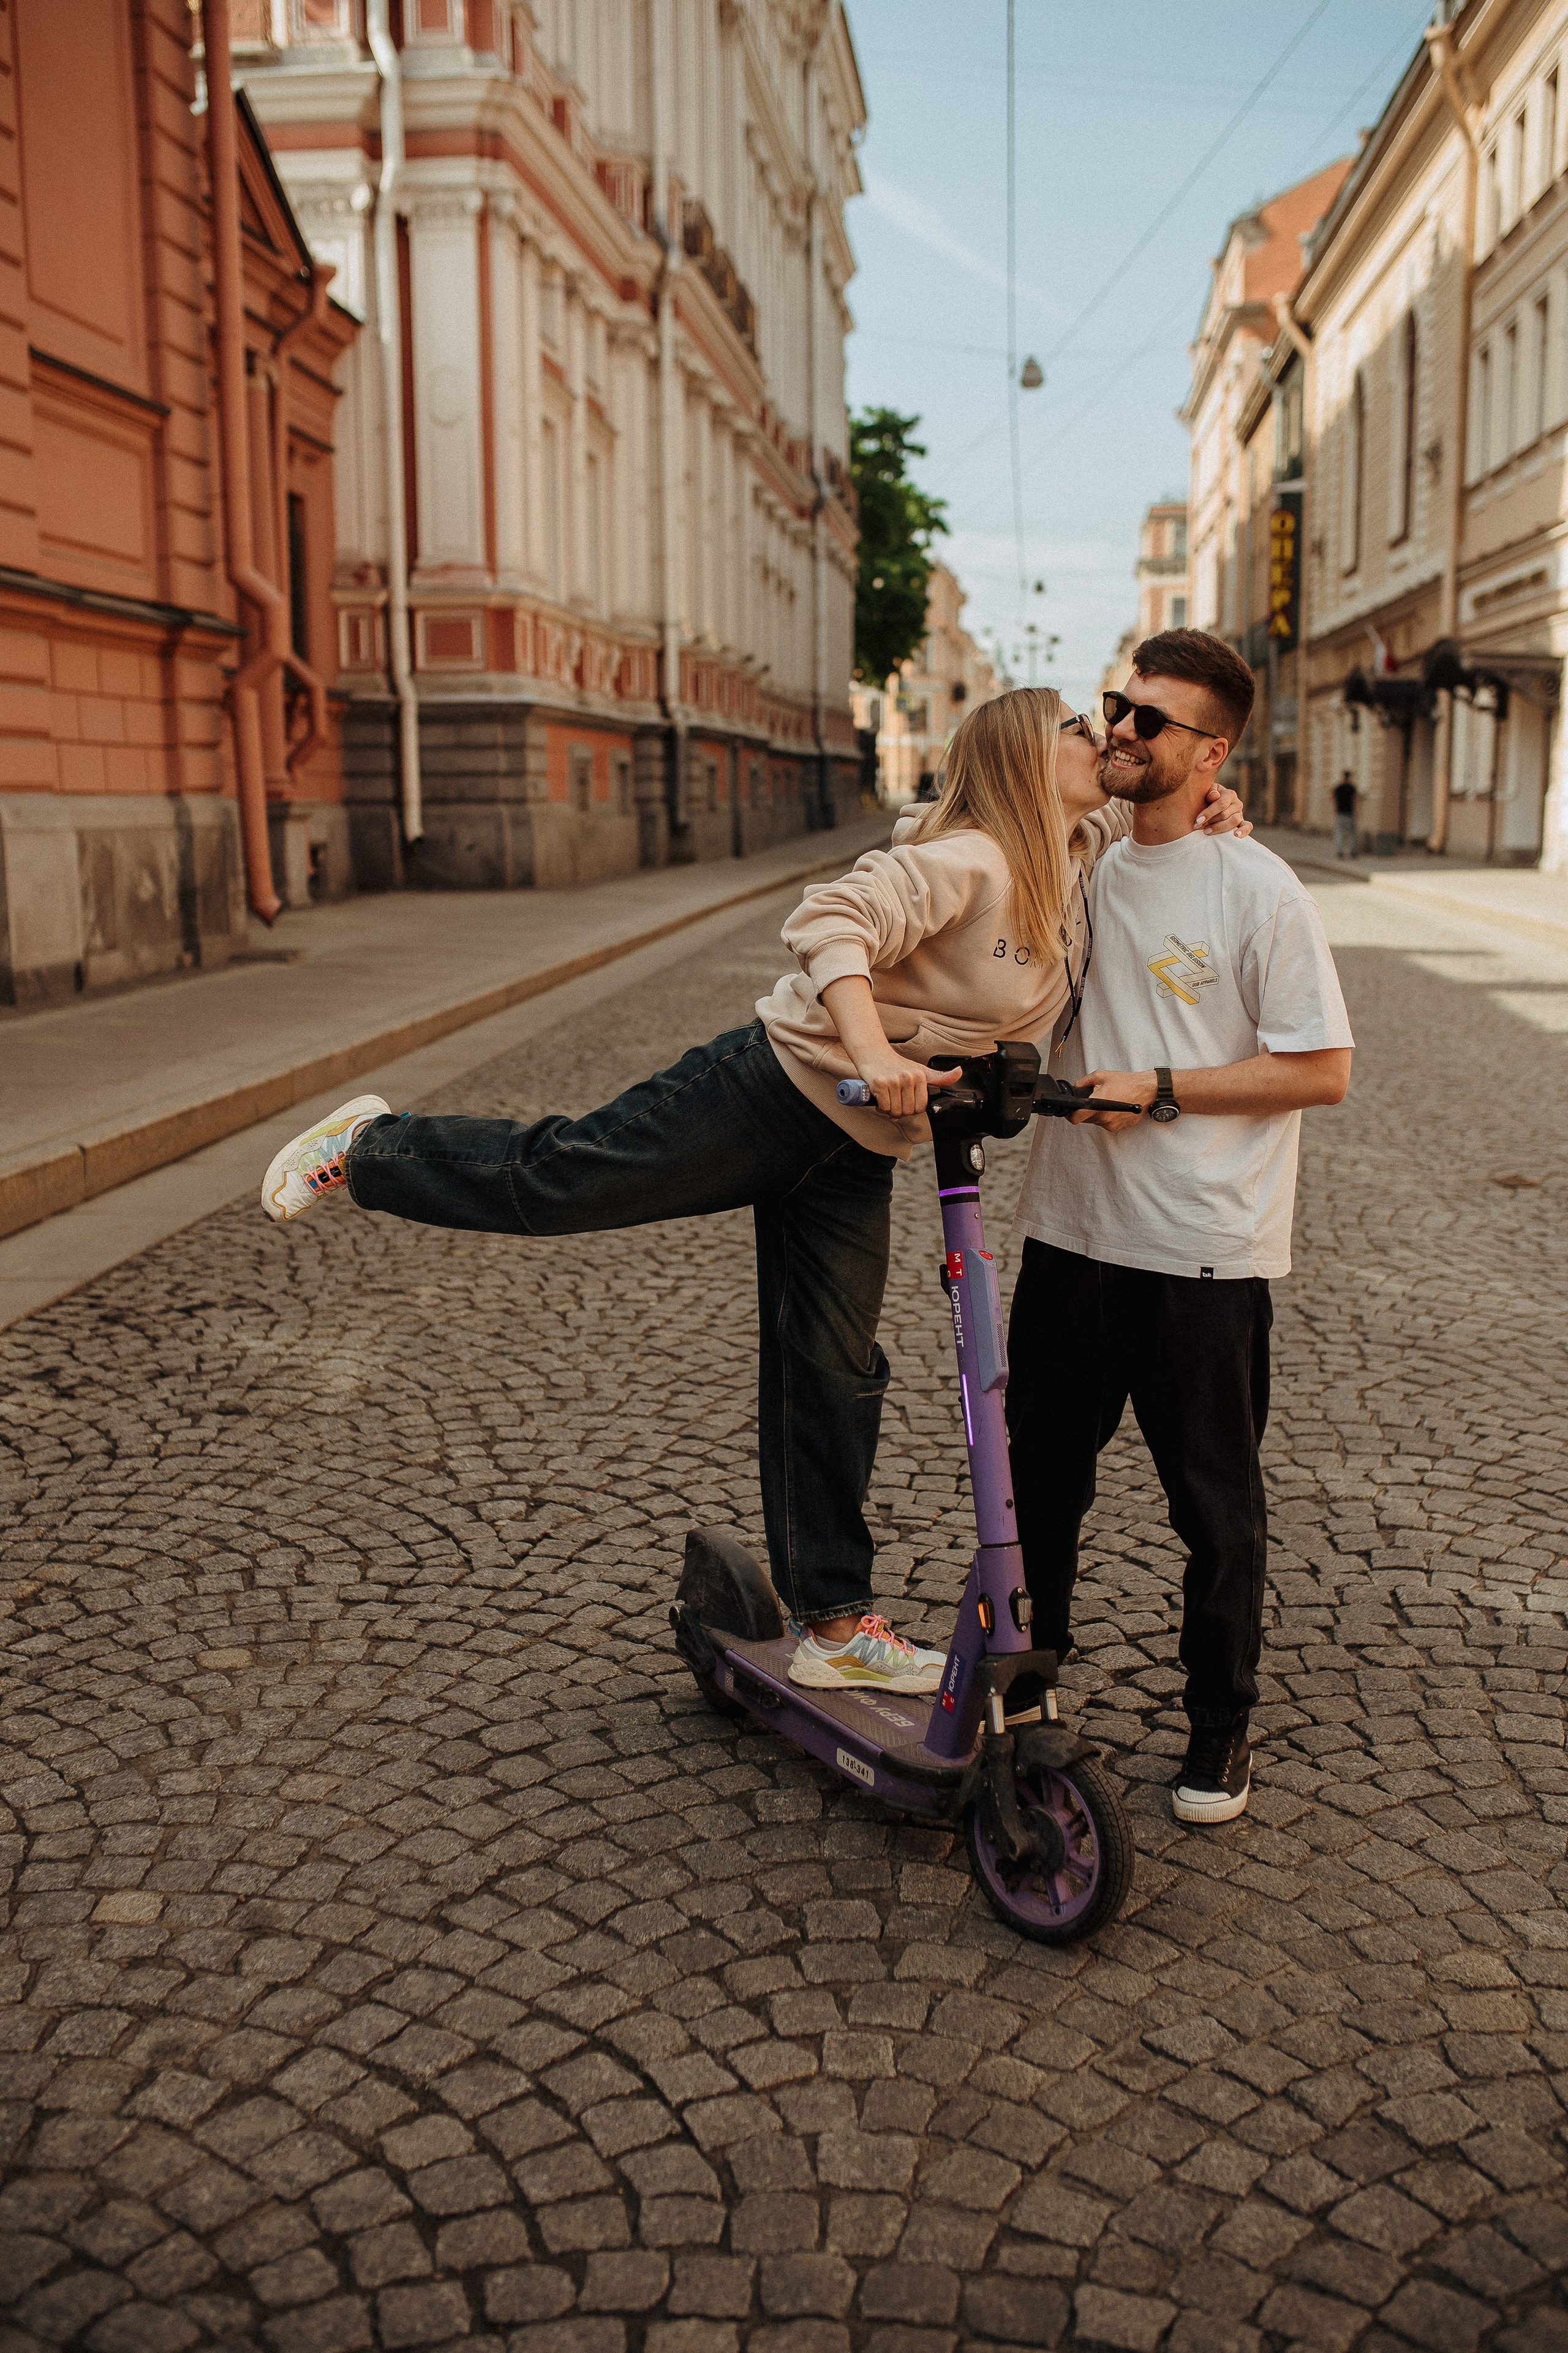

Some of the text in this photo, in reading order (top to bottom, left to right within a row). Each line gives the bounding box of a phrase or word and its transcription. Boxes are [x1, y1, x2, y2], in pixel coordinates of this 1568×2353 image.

[1169, 935, 1207, 969] GEOMETRIC DELUSION
[951, 1286, 964, 1347] ЮРЕНТ
[949, 1655, 960, 1692] ЮРЕНТ
[870, 1707, 915, 1728] БЕРУ
[842, 1756, 869, 1779] 138-341
